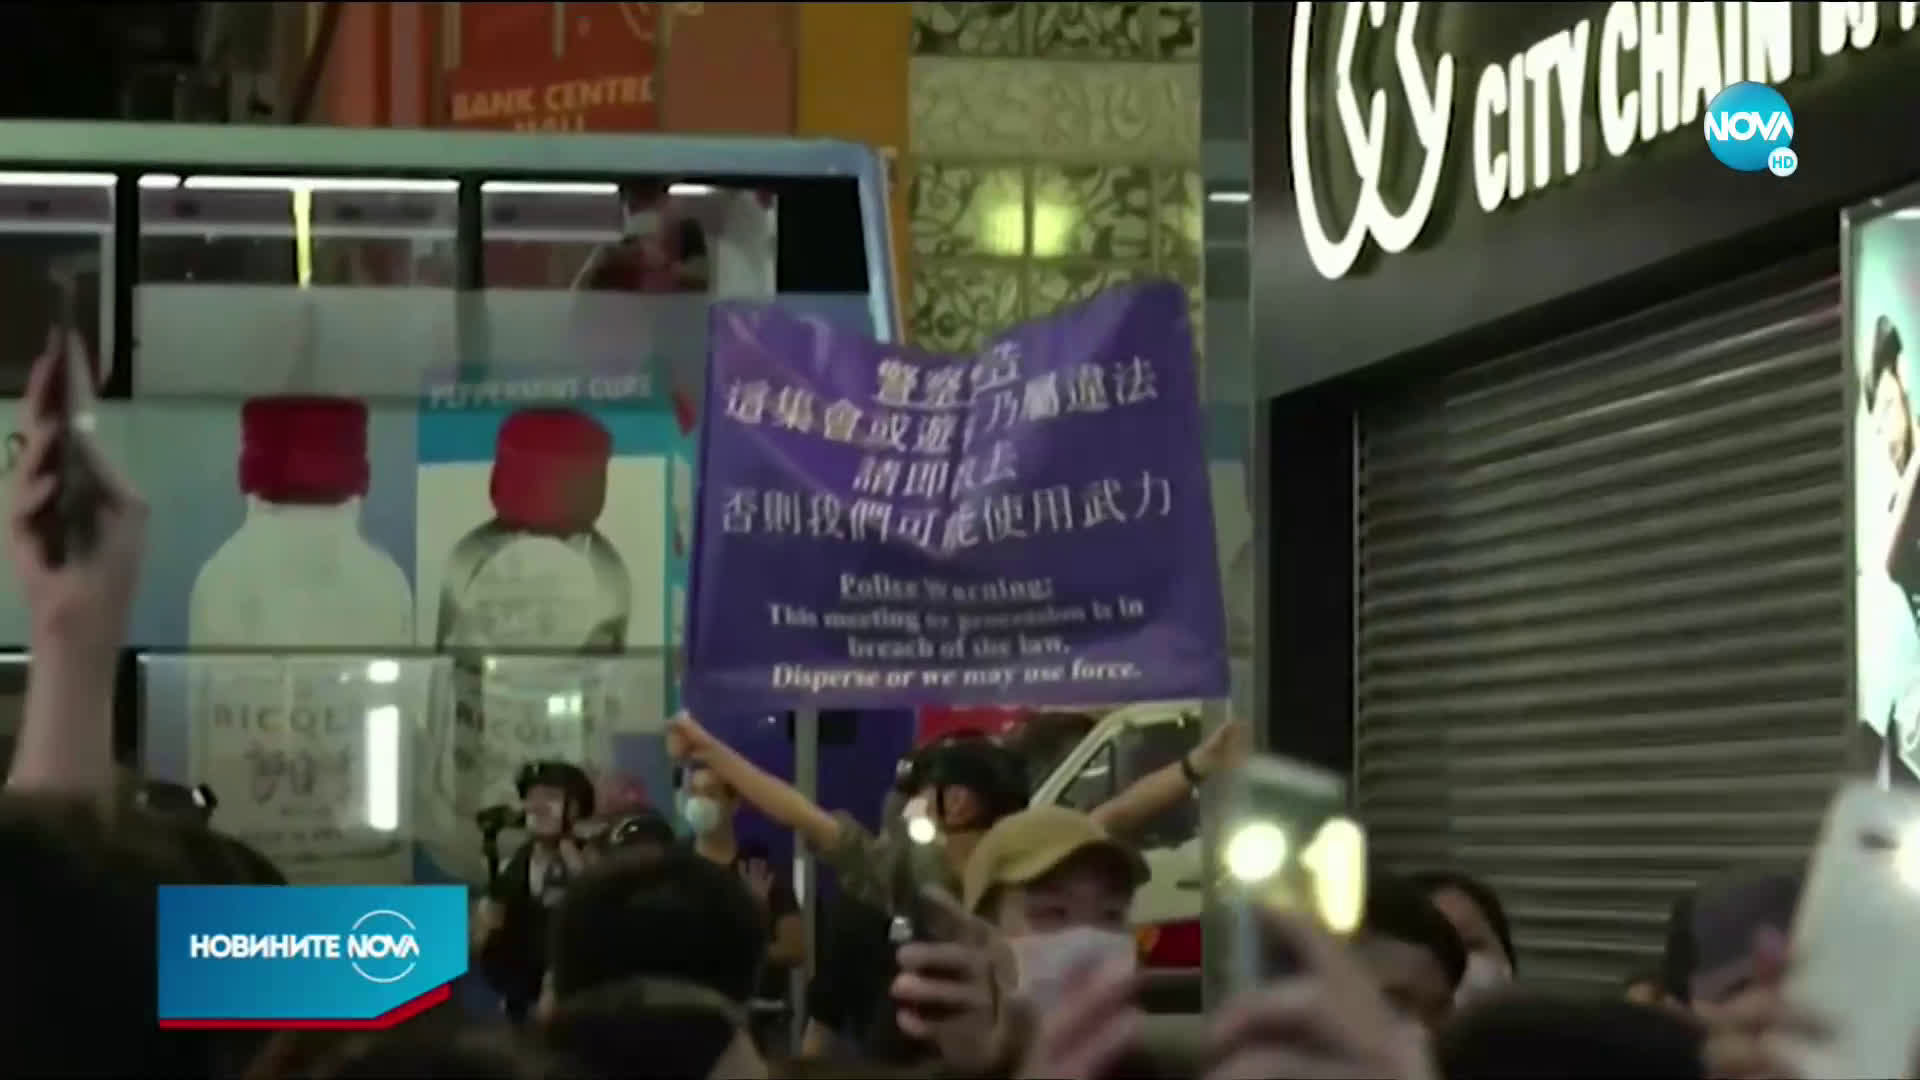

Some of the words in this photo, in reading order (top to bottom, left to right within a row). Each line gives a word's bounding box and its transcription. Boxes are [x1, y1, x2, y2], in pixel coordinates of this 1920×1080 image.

[452, 86, 535, 120] BANK
[1473, 20, 1590, 212] CITY
[1599, 2, 1792, 156] CHAIN
[771, 604, 818, 627] This
[1118, 595, 1144, 618] in
[848, 635, 935, 659] breach
[940, 634, 966, 658] of
[772, 661, 880, 695] Disperse
[886, 670, 916, 688] or
[921, 669, 958, 688] we
[962, 667, 1015, 697] may
[1022, 666, 1065, 685] use
[1071, 657, 1143, 683] force.
